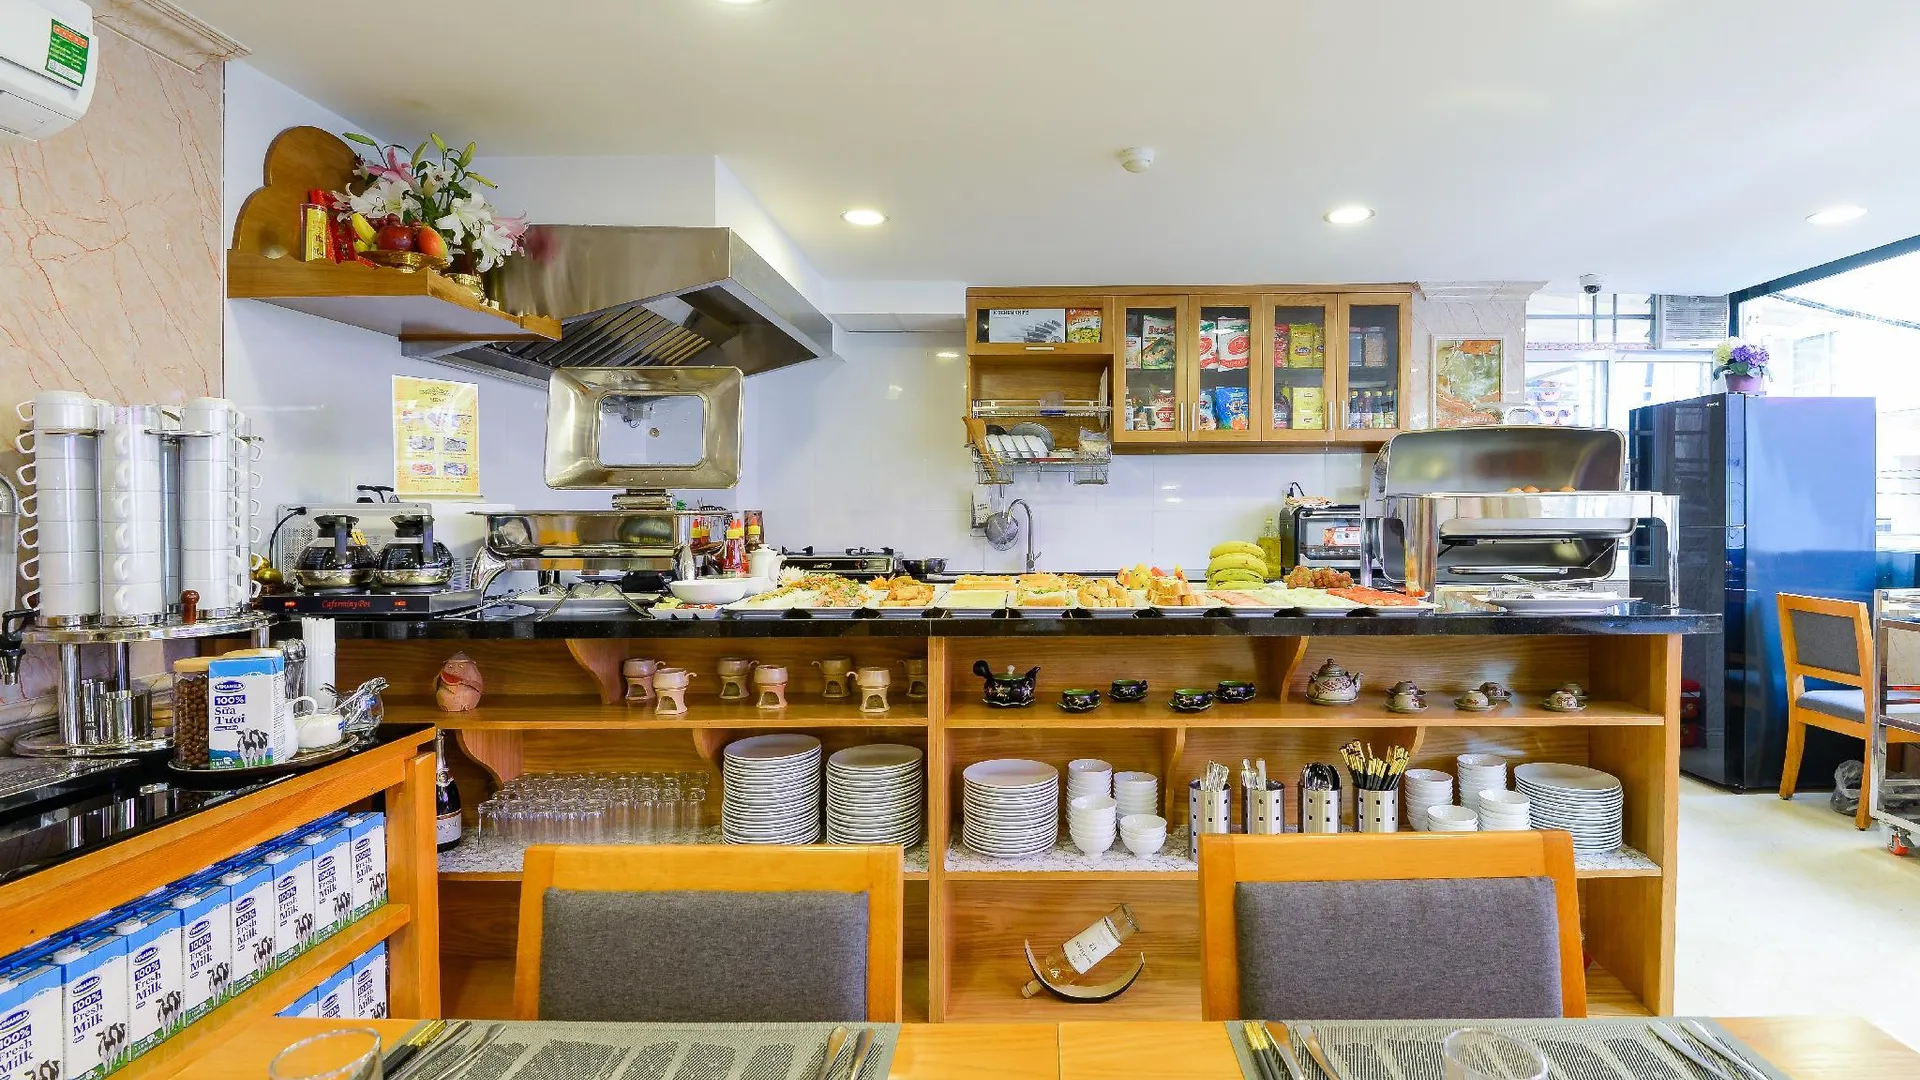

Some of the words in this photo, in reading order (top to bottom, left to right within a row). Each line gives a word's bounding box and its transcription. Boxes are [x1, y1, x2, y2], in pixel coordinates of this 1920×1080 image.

[215, 696, 245, 705] 100%
[280, 905, 298, 920] Milk
[190, 933, 211, 952] 100%
[237, 928, 258, 945] Milk
[190, 944, 212, 962] Fresh
[191, 953, 213, 973] Milk
[136, 960, 160, 981] 100%
[136, 971, 161, 991] Fresh
[74, 991, 101, 1013] 100%
[136, 981, 162, 1003] Milk
[74, 1003, 103, 1024] Fresh
[74, 1014, 103, 1036] Milk
